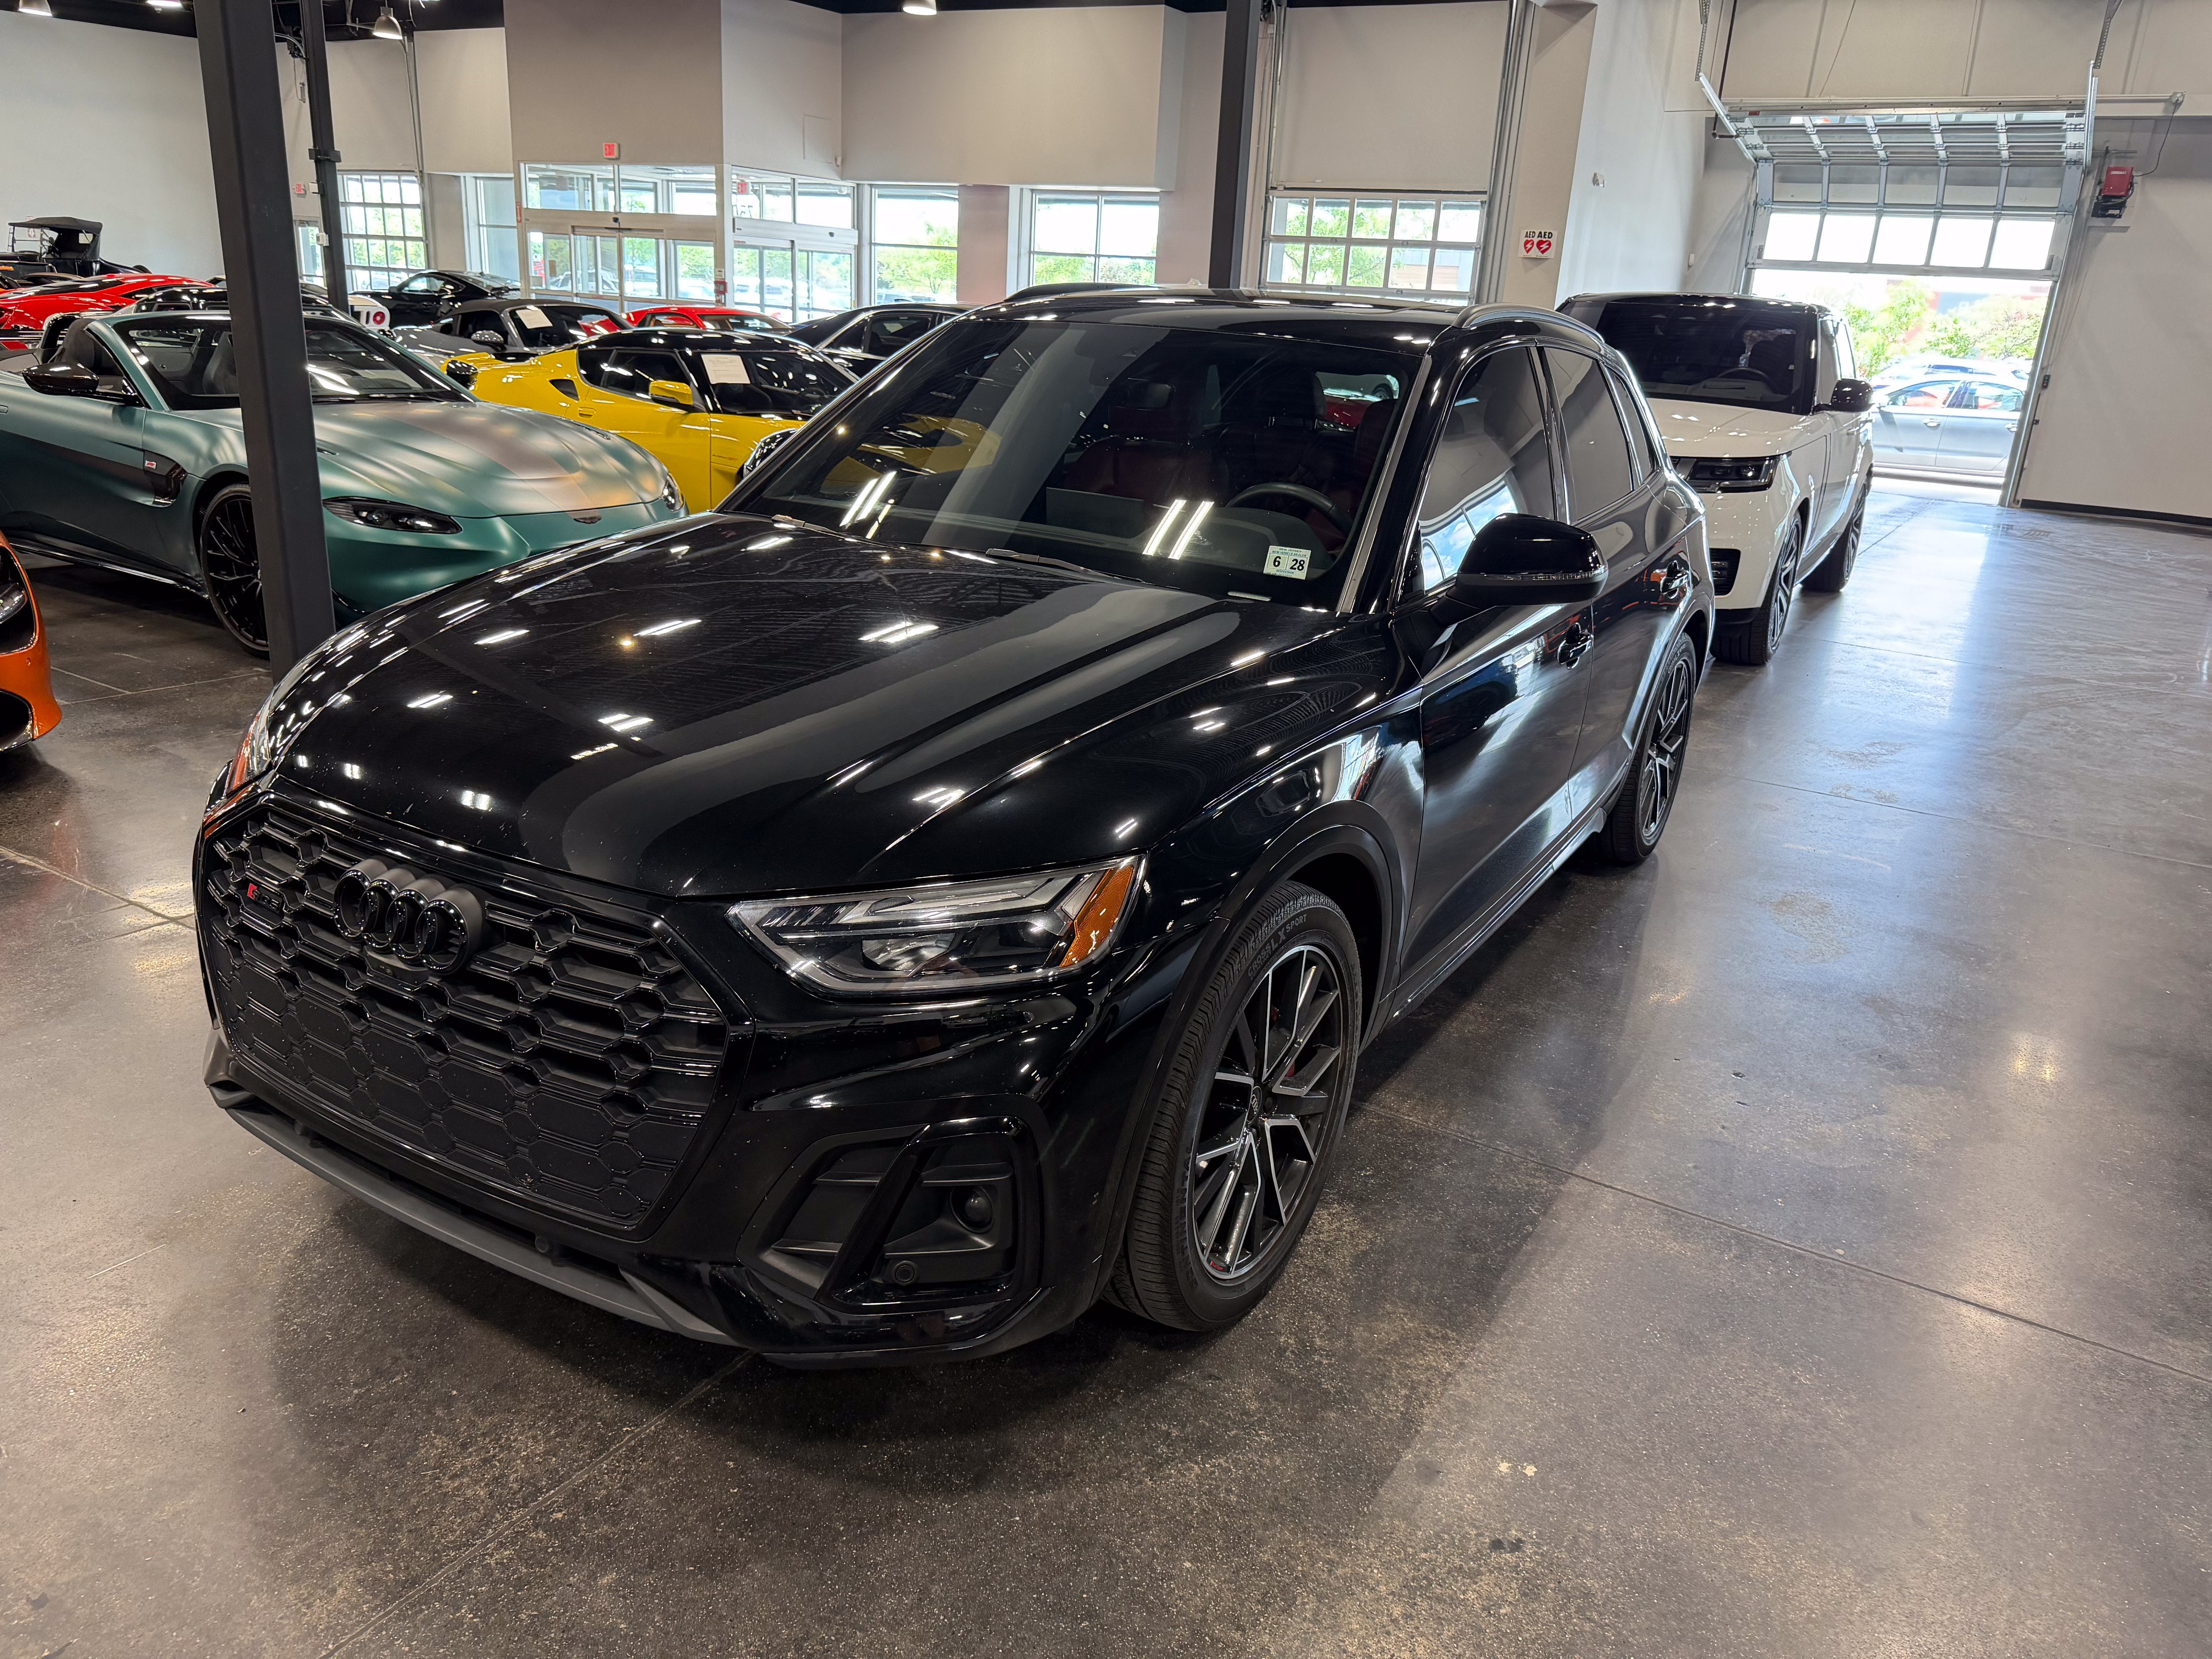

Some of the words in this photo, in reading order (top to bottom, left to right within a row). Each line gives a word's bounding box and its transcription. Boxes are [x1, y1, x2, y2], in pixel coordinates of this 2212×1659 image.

[1273, 556, 1281, 567] 6
[1290, 559, 1305, 571] 28
[1248, 943, 1271, 977] CROSS
[1286, 914, 1307, 933] SPORT
